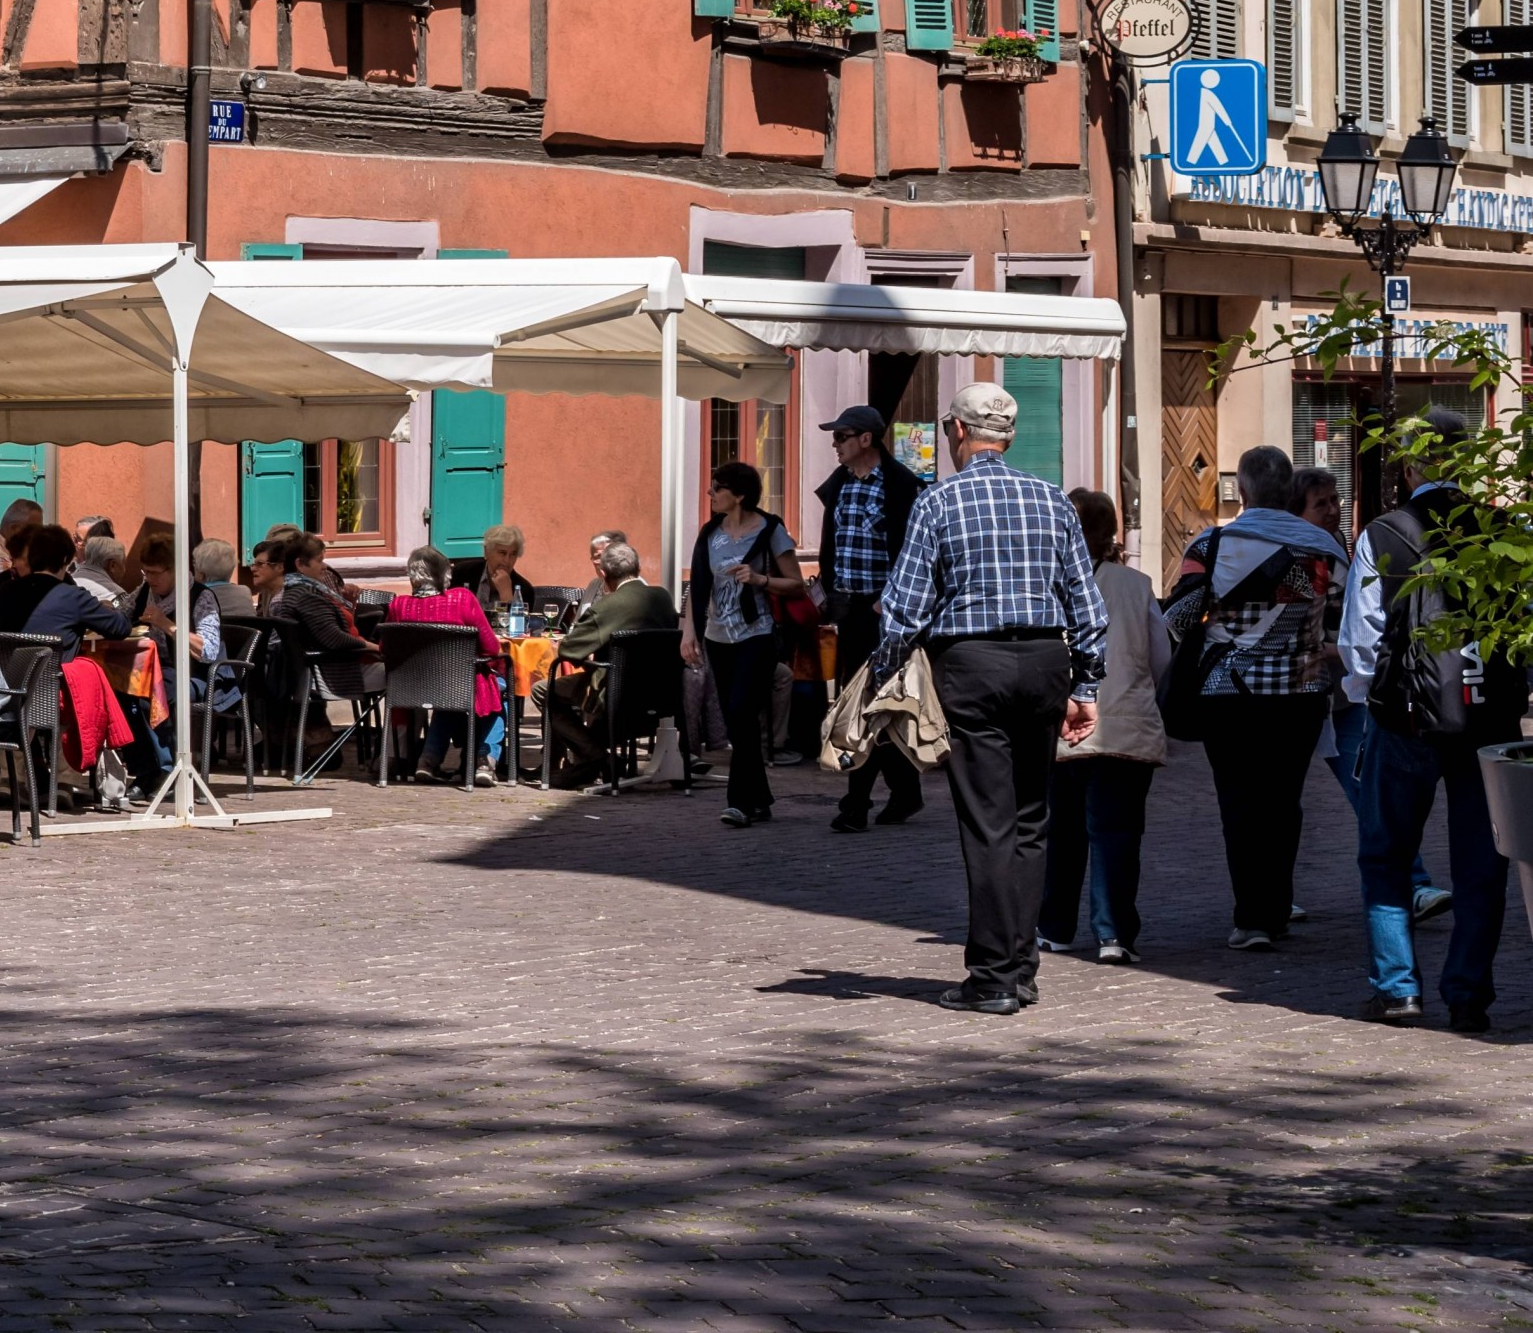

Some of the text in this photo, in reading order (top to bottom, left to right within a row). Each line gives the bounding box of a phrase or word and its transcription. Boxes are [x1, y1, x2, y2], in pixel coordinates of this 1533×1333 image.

[1116, 19, 1175, 42] Pfeffel
[212, 104, 232, 118] RUE
[217, 118, 227, 126] DU
[208, 125, 242, 141] EMPART
[1460, 640, 1486, 705] FILA
